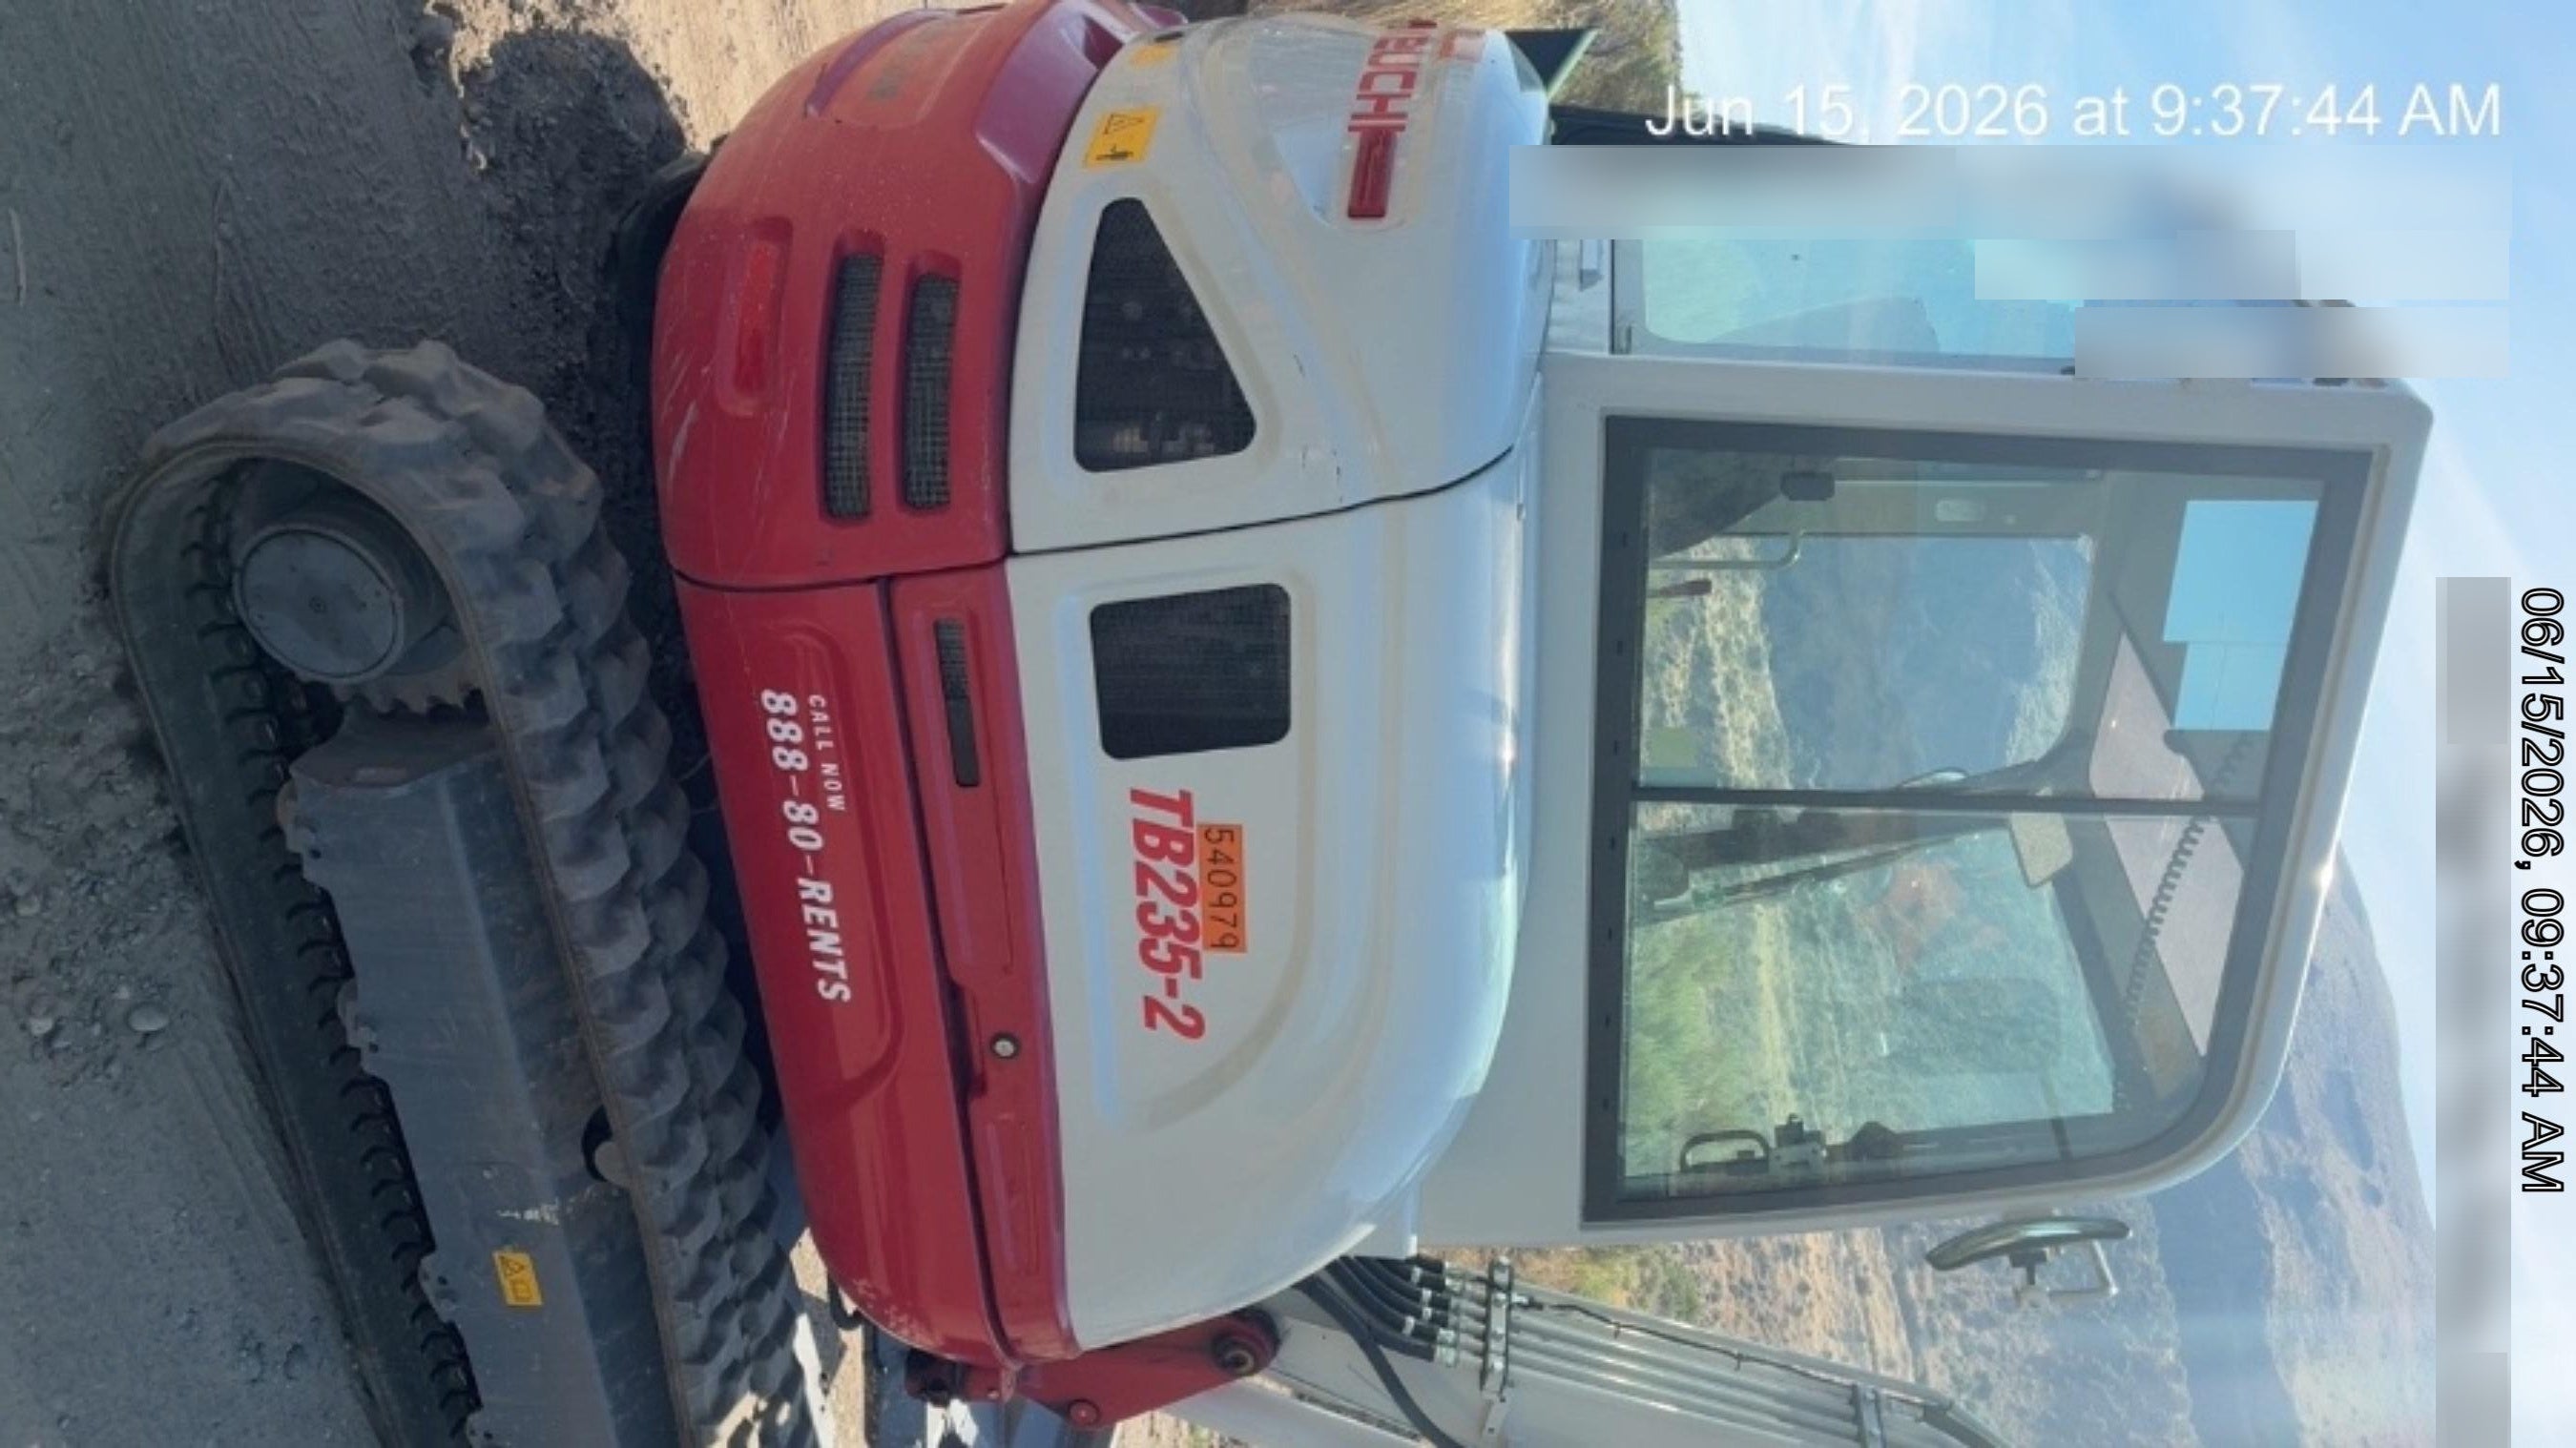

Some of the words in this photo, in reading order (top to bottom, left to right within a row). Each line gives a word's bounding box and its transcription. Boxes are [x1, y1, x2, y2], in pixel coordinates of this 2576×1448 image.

[1347, 19, 1437, 132] EUCHI
[809, 694, 835, 751] CALL
[761, 689, 852, 1003] 888-80-RENTS
[821, 762, 847, 812] NOW
[1130, 787, 1206, 1041] TB235-2
[1203, 827, 1240, 951] 540979
